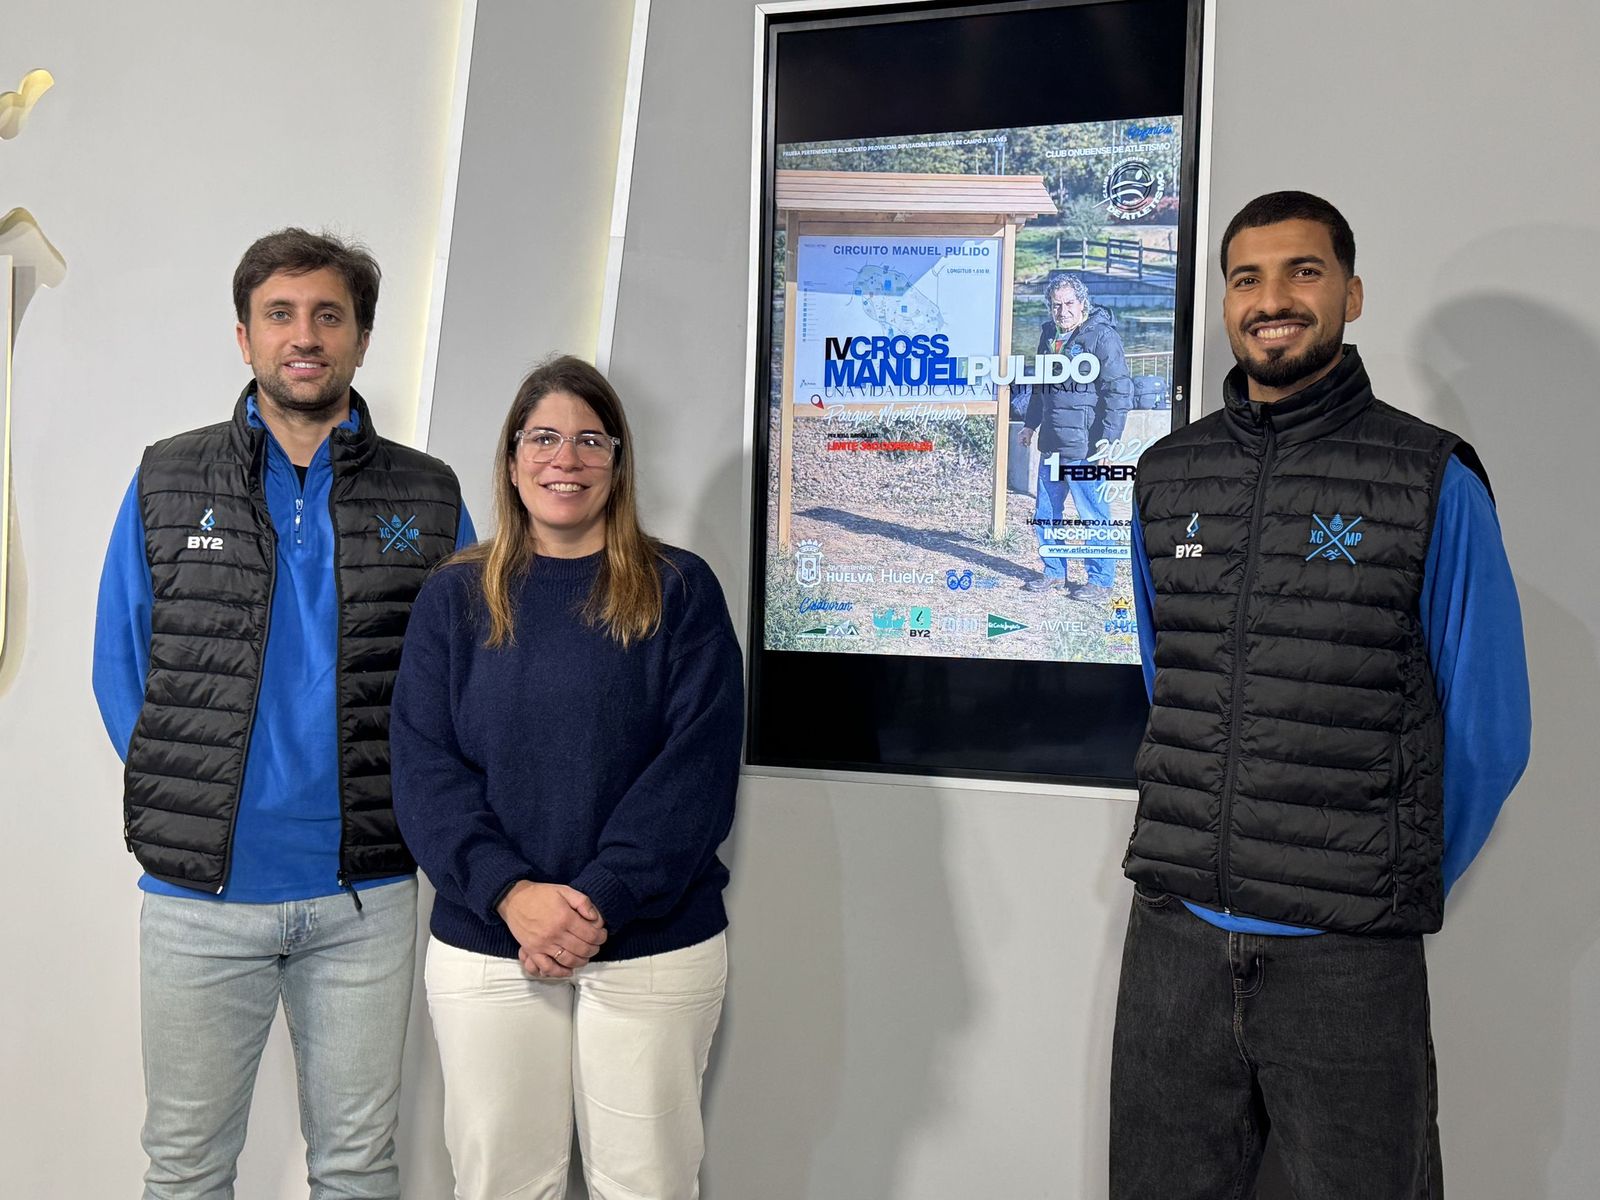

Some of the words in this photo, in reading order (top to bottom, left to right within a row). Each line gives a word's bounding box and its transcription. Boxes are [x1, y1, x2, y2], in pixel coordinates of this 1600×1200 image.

[1045, 149, 1067, 158] CLUB
[1067, 145, 1112, 157] ONUBENSE
[1112, 145, 1124, 154] DE
[1124, 142, 1171, 153] ATLETISMO
[1106, 203, 1123, 218] DE
[1120, 171, 1165, 220] ATLETISMO
[833, 245, 889, 256] CIRCUITO
[892, 245, 942, 257] MANUEL
[944, 246, 990, 257] PULIDO
[850, 334, 949, 360] CROSS
[824, 357, 968, 388] MANUEL
[967, 353, 1101, 386] PULIDO
[824, 385, 854, 398] UNA
[859, 385, 894, 397] VIDA
[899, 384, 976, 397] DEDICADA
[981, 383, 999, 396] AL
[1005, 382, 1089, 395] ATLETISMO
[823, 404, 875, 428] Parque
[1044, 452, 1060, 482] 1
[405, 528, 420, 540] MP
[1344, 532, 1363, 547] MP
[187, 536, 223, 550] BY2
[1047, 546, 1128, 555] www.atletismofaa.es
[1175, 544, 1203, 559] BY2
[826, 572, 874, 583] HUELVA
[881, 568, 934, 584] Huelva
[909, 629, 931, 638] BY2
[1039, 620, 1087, 632] AVATEL
